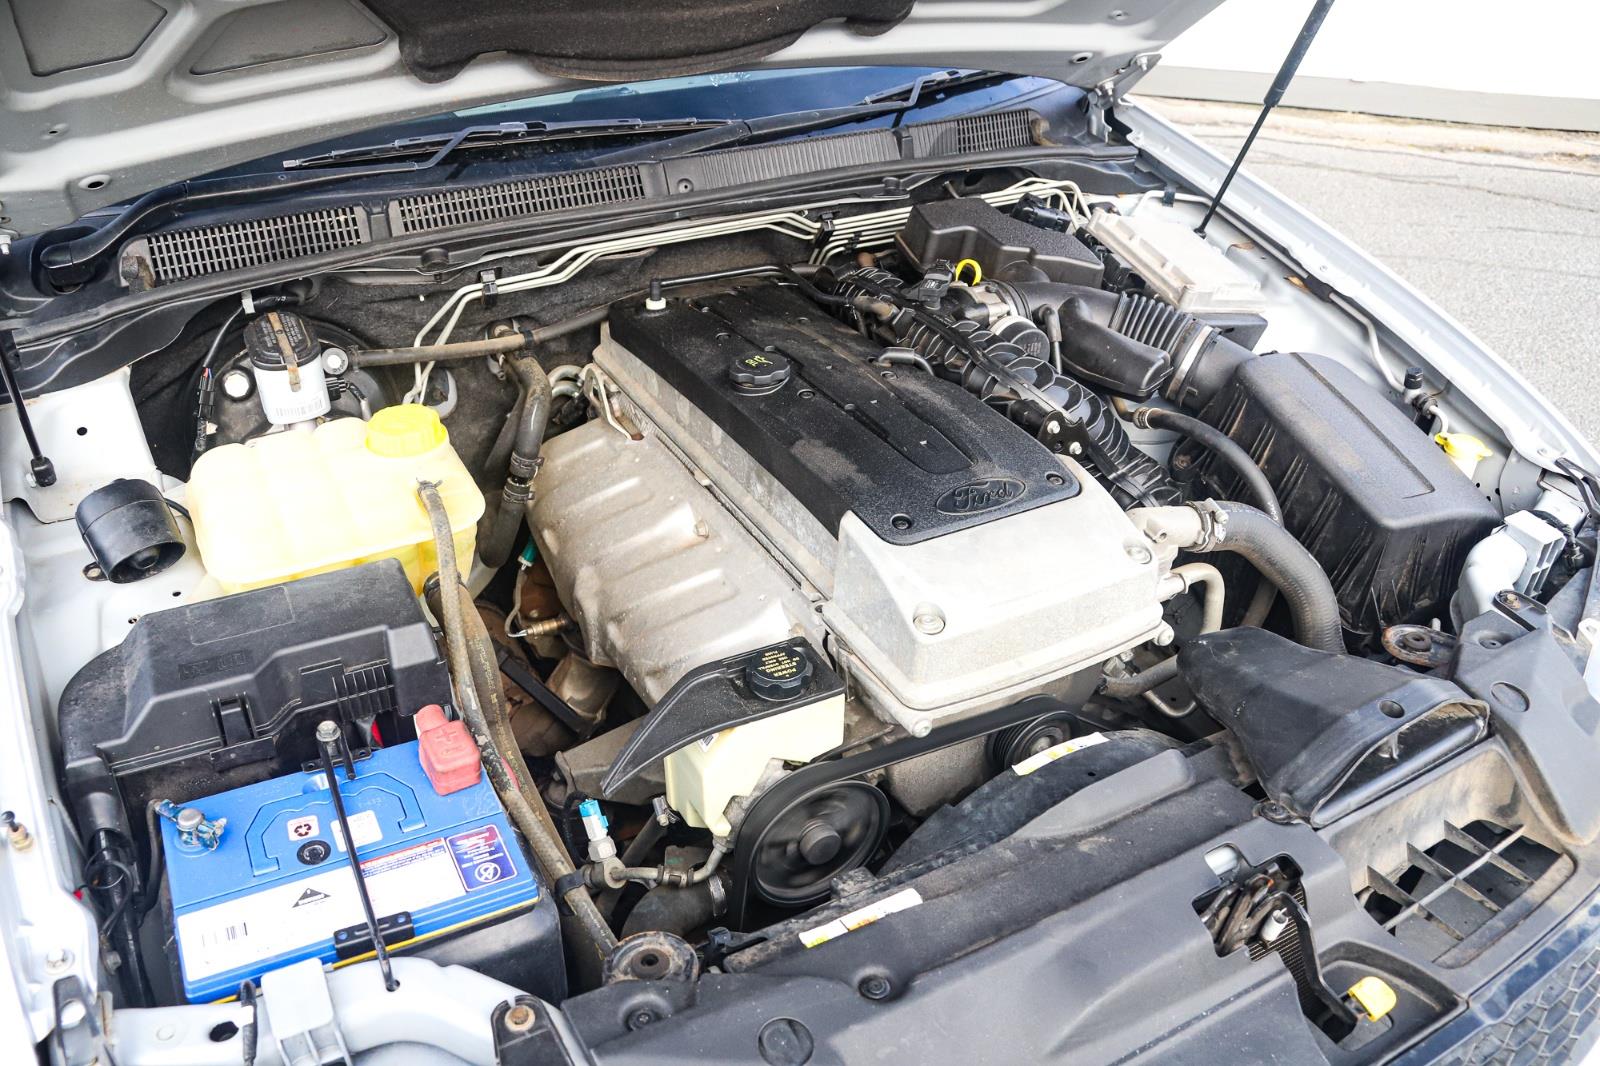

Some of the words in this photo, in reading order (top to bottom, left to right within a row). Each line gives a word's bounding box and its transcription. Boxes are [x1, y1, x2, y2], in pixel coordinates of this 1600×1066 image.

[954, 480, 1014, 511] Ford
[766, 662, 797, 673] STEERING
[773, 668, 796, 677] POWER
